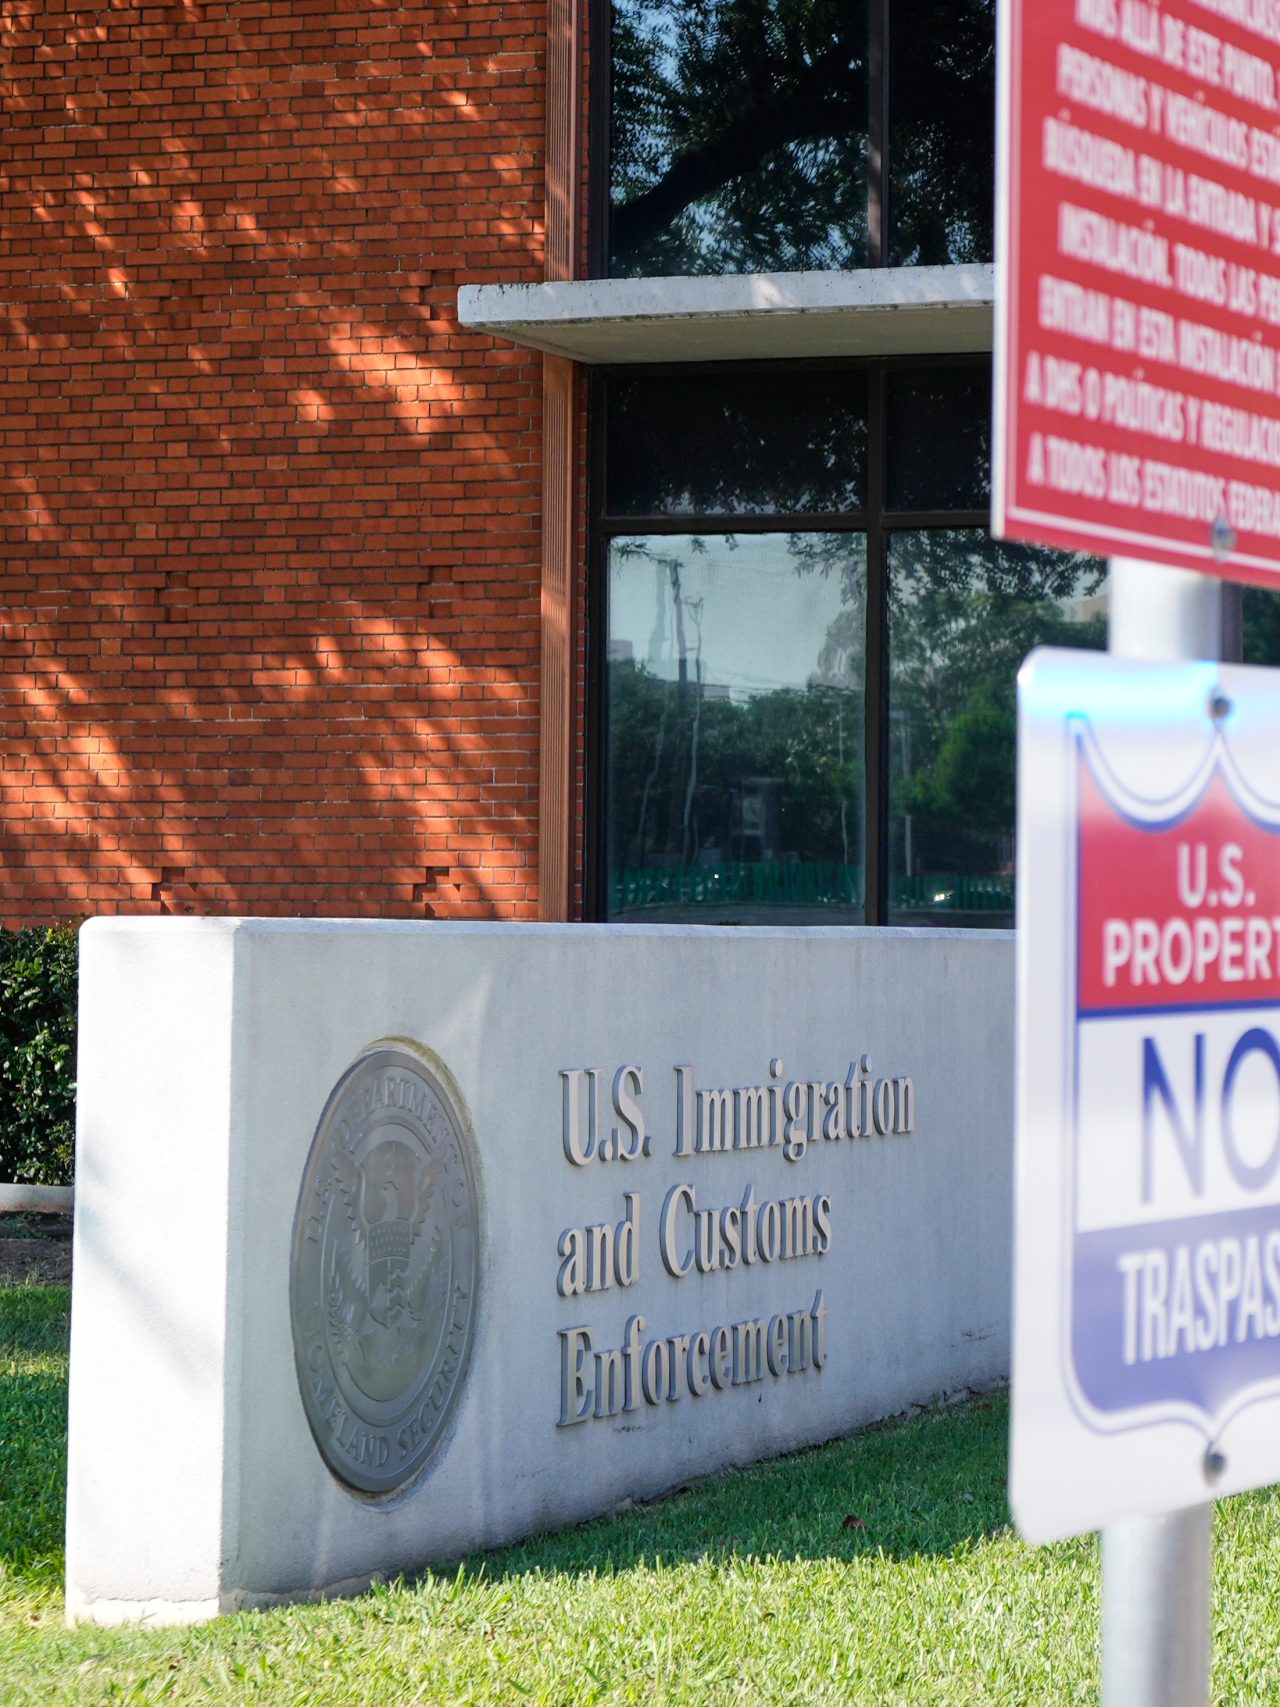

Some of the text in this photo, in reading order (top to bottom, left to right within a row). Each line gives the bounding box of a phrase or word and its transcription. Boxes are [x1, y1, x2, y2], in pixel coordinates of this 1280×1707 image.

[1056, 41, 1148, 128] PERSONAS
[1149, 82, 1164, 136] Y
[1164, 89, 1248, 169] VEHÍCULOS
[1042, 109, 1136, 199] BÚSQUEDA
[1136, 153, 1162, 211] EN
[1163, 164, 1184, 219] LA
[1186, 173, 1257, 244] ENTRADA
[1258, 202, 1271, 251] Y
[1037, 273, 1110, 344] ENTRAN
[1111, 296, 1137, 353] EN
[1138, 305, 1176, 363] ESTA
[1176, 318, 1275, 392] INSTALACIÓN
[1173, 242, 1227, 306] TODAS
[1227, 262, 1257, 317] LAS
[1023, 349, 1043, 405] A
[1082, 366, 1100, 420] O
[1101, 368, 1185, 440] POLÍTICAS
[1185, 395, 1201, 445] Y
[1026, 430, 1045, 484] A
[1045, 435, 1106, 496] TODOS
[1106, 450, 1141, 506] LOS
[1141, 459, 1226, 523] ESTATUTOS
[1176, 842, 1257, 911] U.S.
[558, 1054, 915, 1167] U.S. Immigration
[556, 1183, 832, 1297] and Customs
[396, 1281, 470, 1461] SECURITY
[556, 1289, 828, 1427] Enforcement
